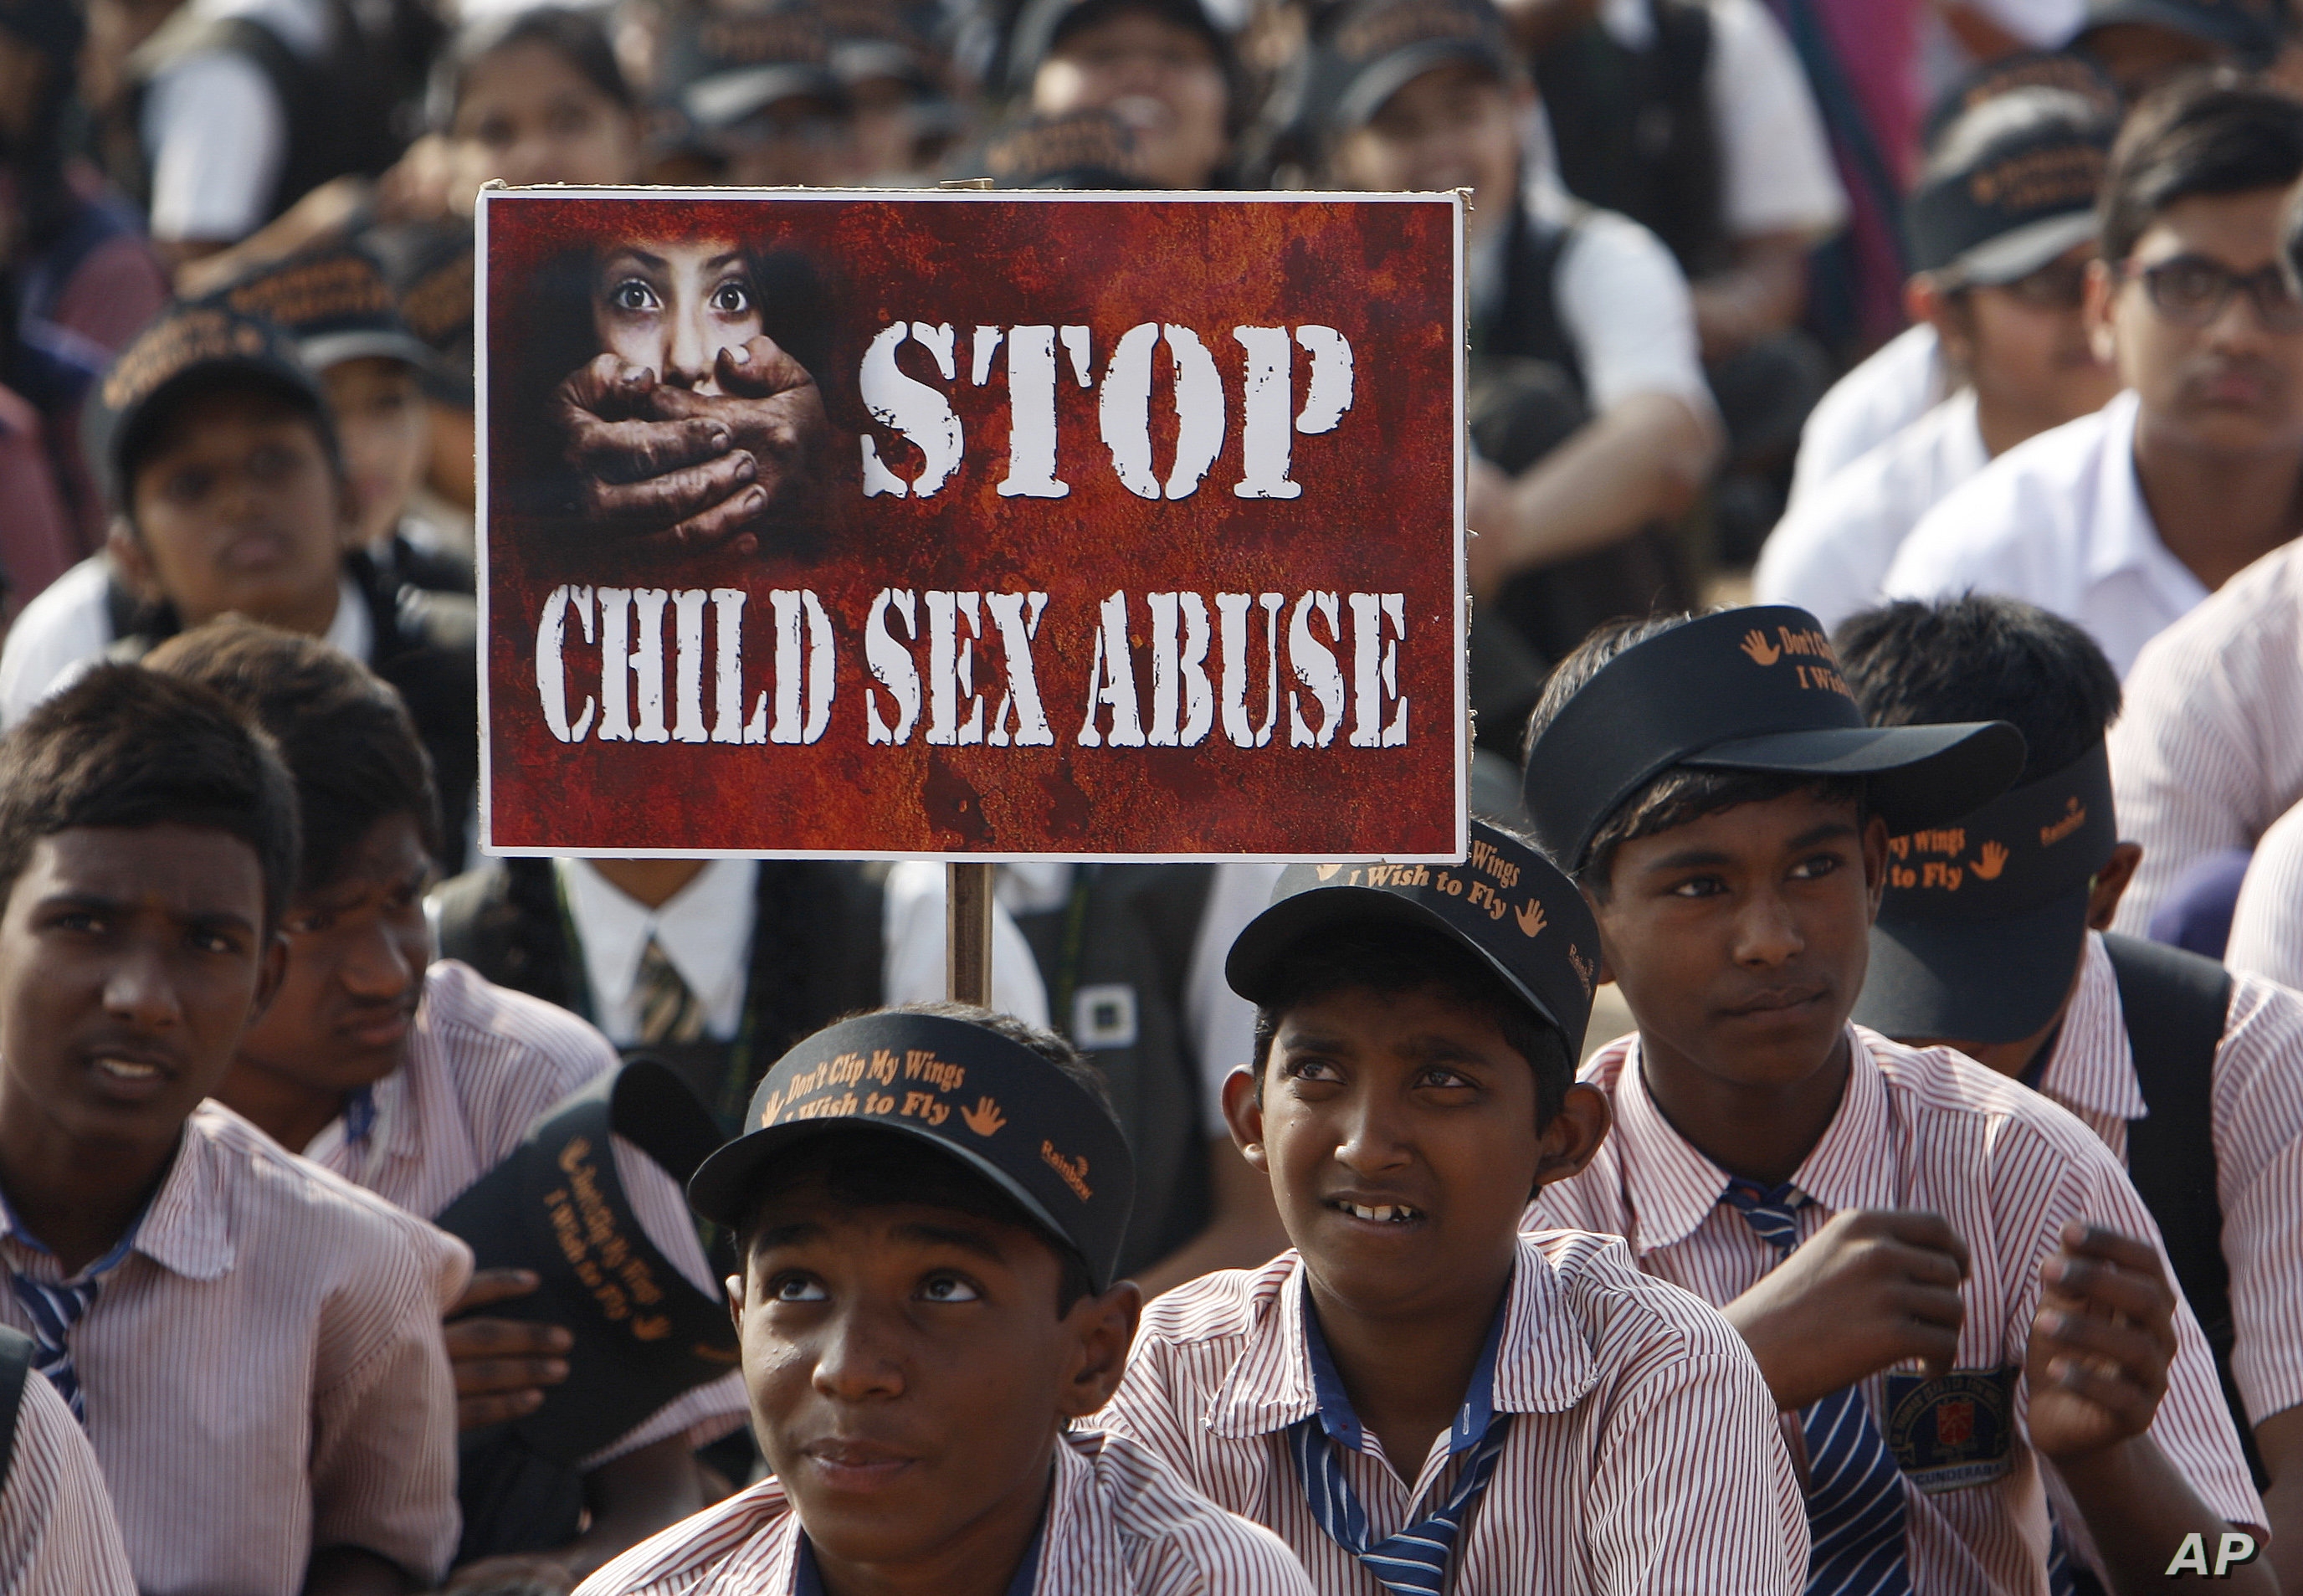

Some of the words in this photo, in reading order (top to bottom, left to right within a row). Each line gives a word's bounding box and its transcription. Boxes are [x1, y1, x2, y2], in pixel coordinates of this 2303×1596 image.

[859, 320, 1355, 501] STOP
[535, 583, 837, 745] CHILD
[864, 587, 1054, 748] SEX
[1078, 589, 1408, 748] ABUSE
[1796, 665, 1809, 689] I
[1472, 840, 1520, 889] Wings
[1913, 828, 1966, 859] Wings
[1367, 864, 1431, 887] Wish
[1436, 871, 1464, 896] to
[1467, 880, 1506, 920] Fly
[1892, 865, 1917, 889] to
[1922, 862, 1963, 892] Fly
[785, 1060, 828, 1106] Don't
[828, 1051, 866, 1088] Clip
[866, 1049, 900, 1086] My
[905, 1049, 966, 1093] Wings
[798, 1091, 859, 1120] Wish
[864, 1091, 895, 1115] to
[900, 1091, 951, 1126] Fly
